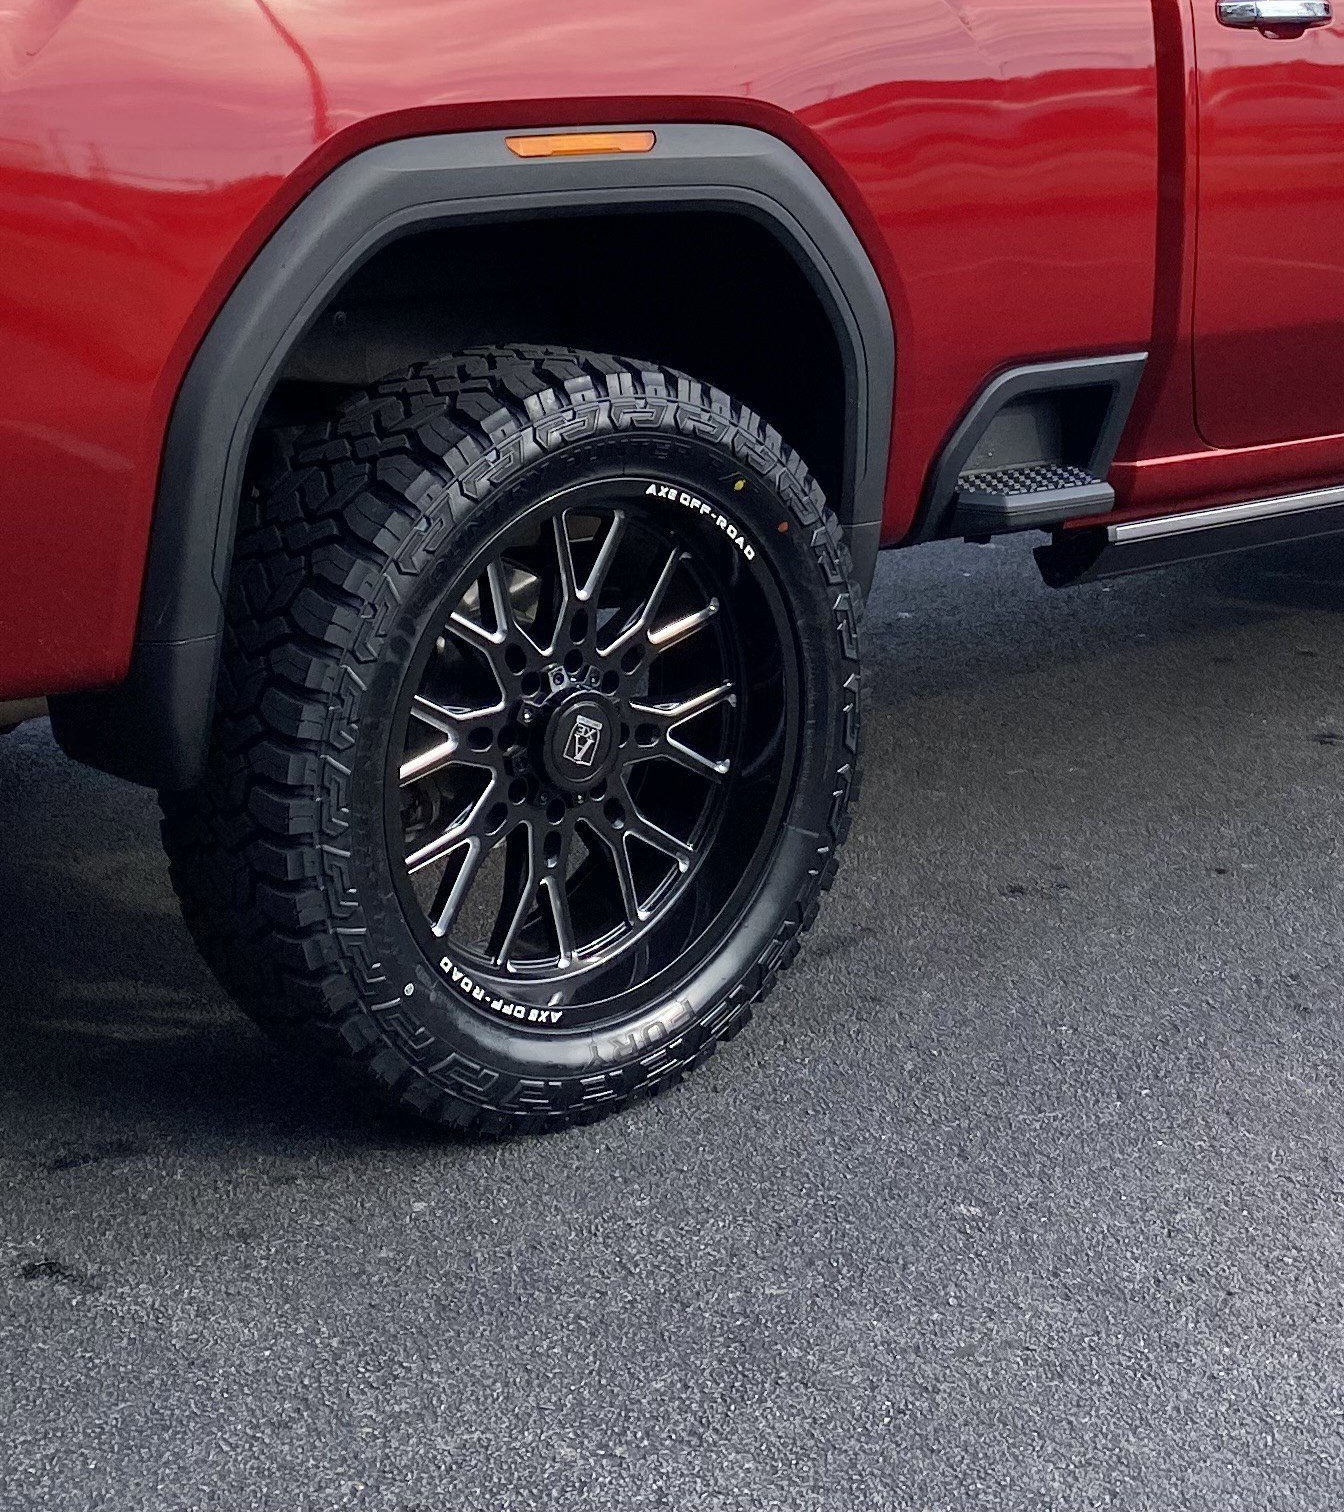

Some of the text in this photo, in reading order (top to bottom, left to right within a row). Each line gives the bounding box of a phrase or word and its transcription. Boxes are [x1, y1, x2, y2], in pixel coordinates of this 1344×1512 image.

[645, 483, 756, 561] AXE OFF-ROAD
[439, 956, 563, 1023] AXE OFF-ROAD
[582, 998, 698, 1072] FURY
